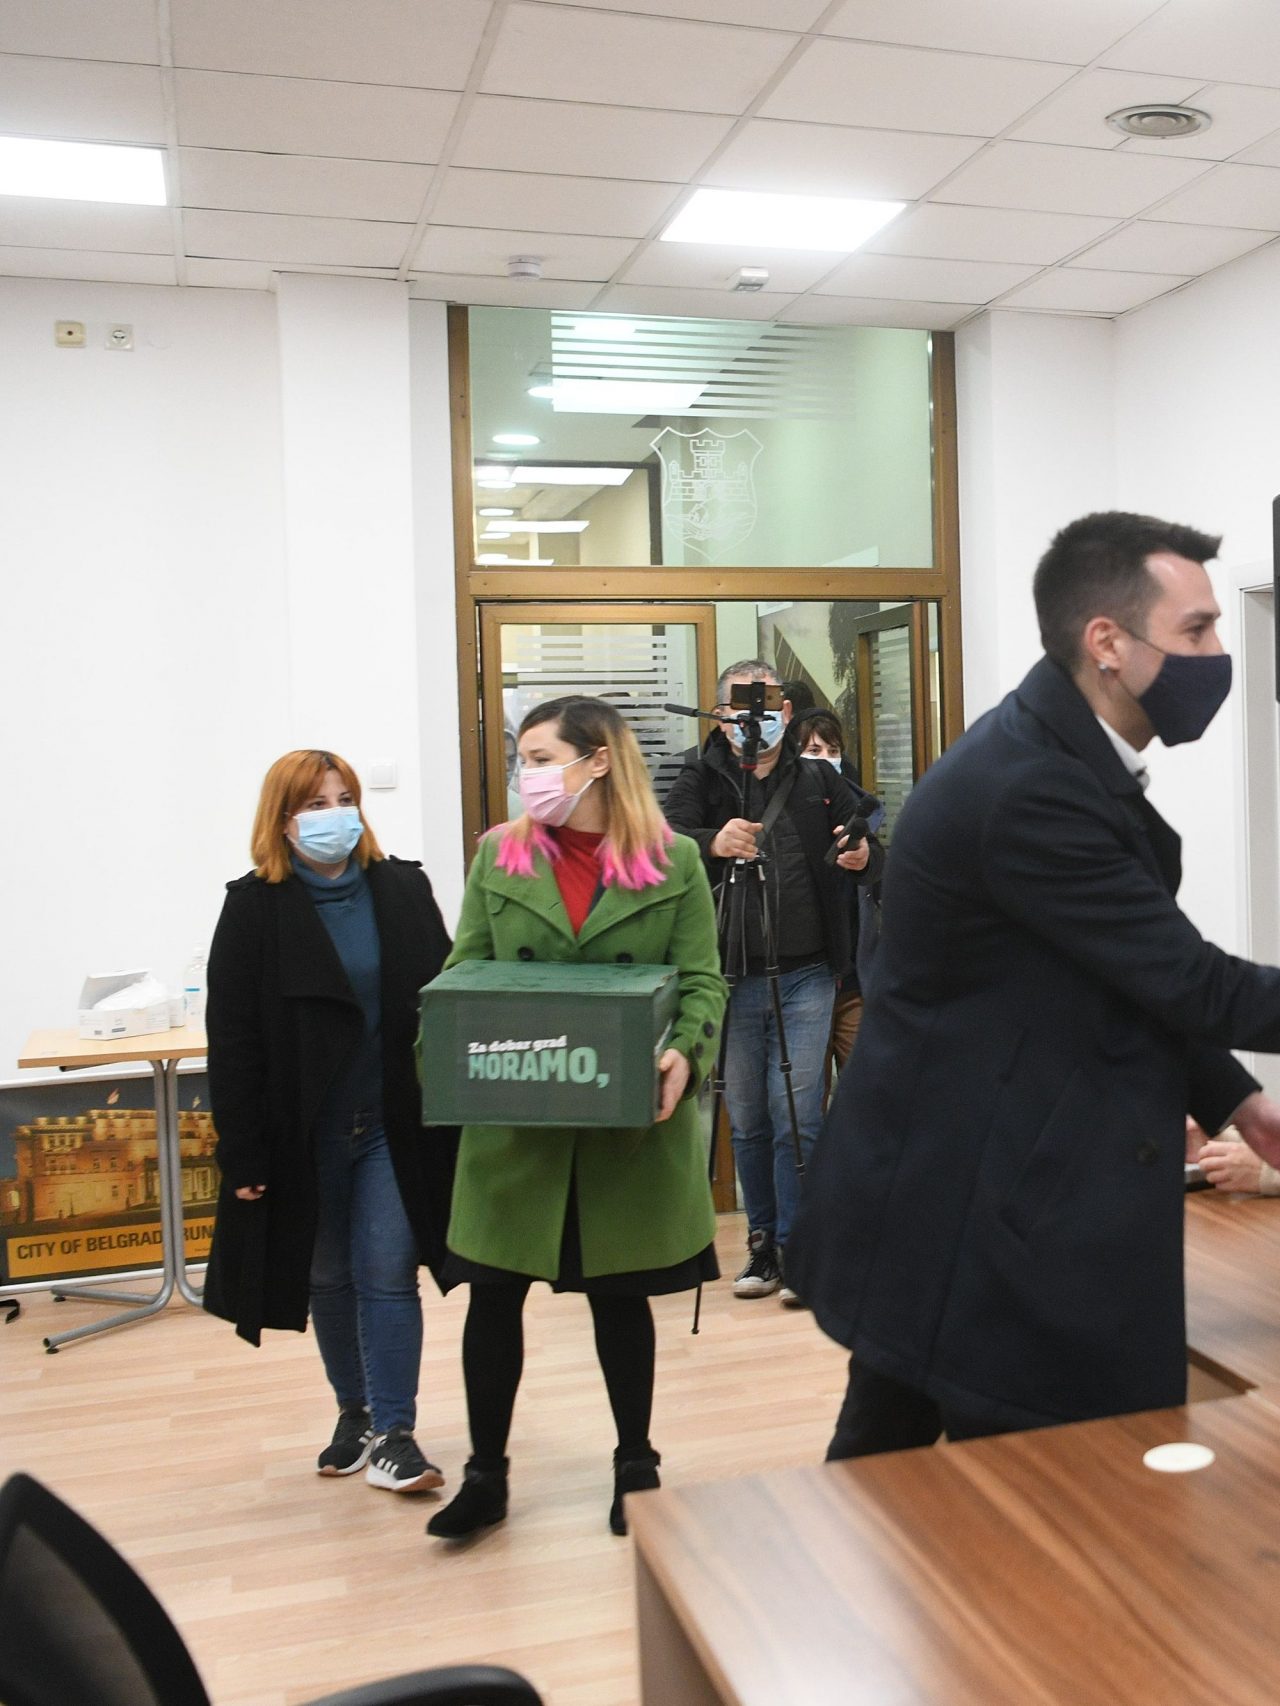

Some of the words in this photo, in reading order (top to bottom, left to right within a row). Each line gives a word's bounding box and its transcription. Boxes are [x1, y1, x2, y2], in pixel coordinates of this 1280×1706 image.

[532, 1035, 568, 1052] grad
[468, 1046, 610, 1089] MORAMO,
[17, 1242, 56, 1260] CITY
[60, 1239, 83, 1255] OF
[86, 1230, 163, 1253] BELGRAD
